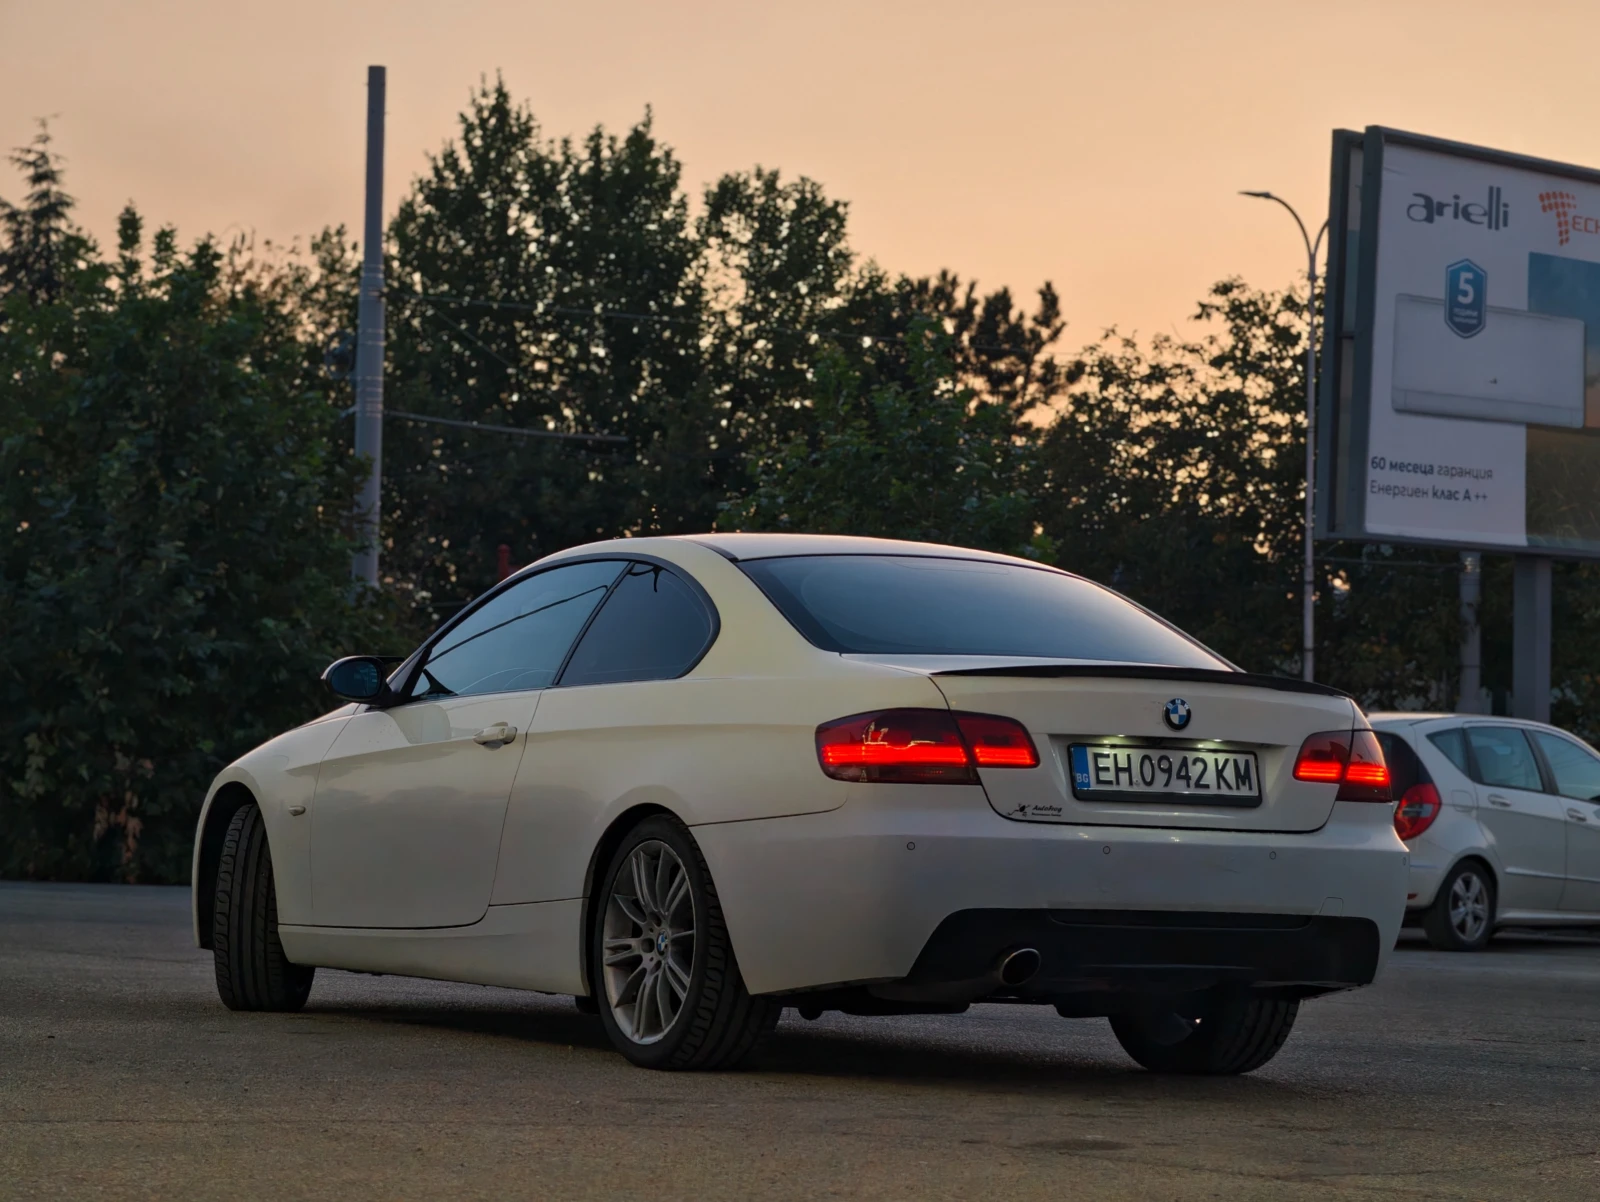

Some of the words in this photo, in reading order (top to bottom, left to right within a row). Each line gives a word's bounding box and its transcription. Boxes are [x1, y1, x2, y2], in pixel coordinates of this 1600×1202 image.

[1406, 185, 1509, 231] arielli
[1457, 271, 1474, 304] 5
[1370, 456, 1386, 470] 60
[1389, 460, 1435, 476] месеца
[1437, 464, 1493, 480] гаранция
[1369, 480, 1429, 498] Енергиен
[1432, 484, 1460, 501] клас
[1076, 774, 1089, 784] BG
